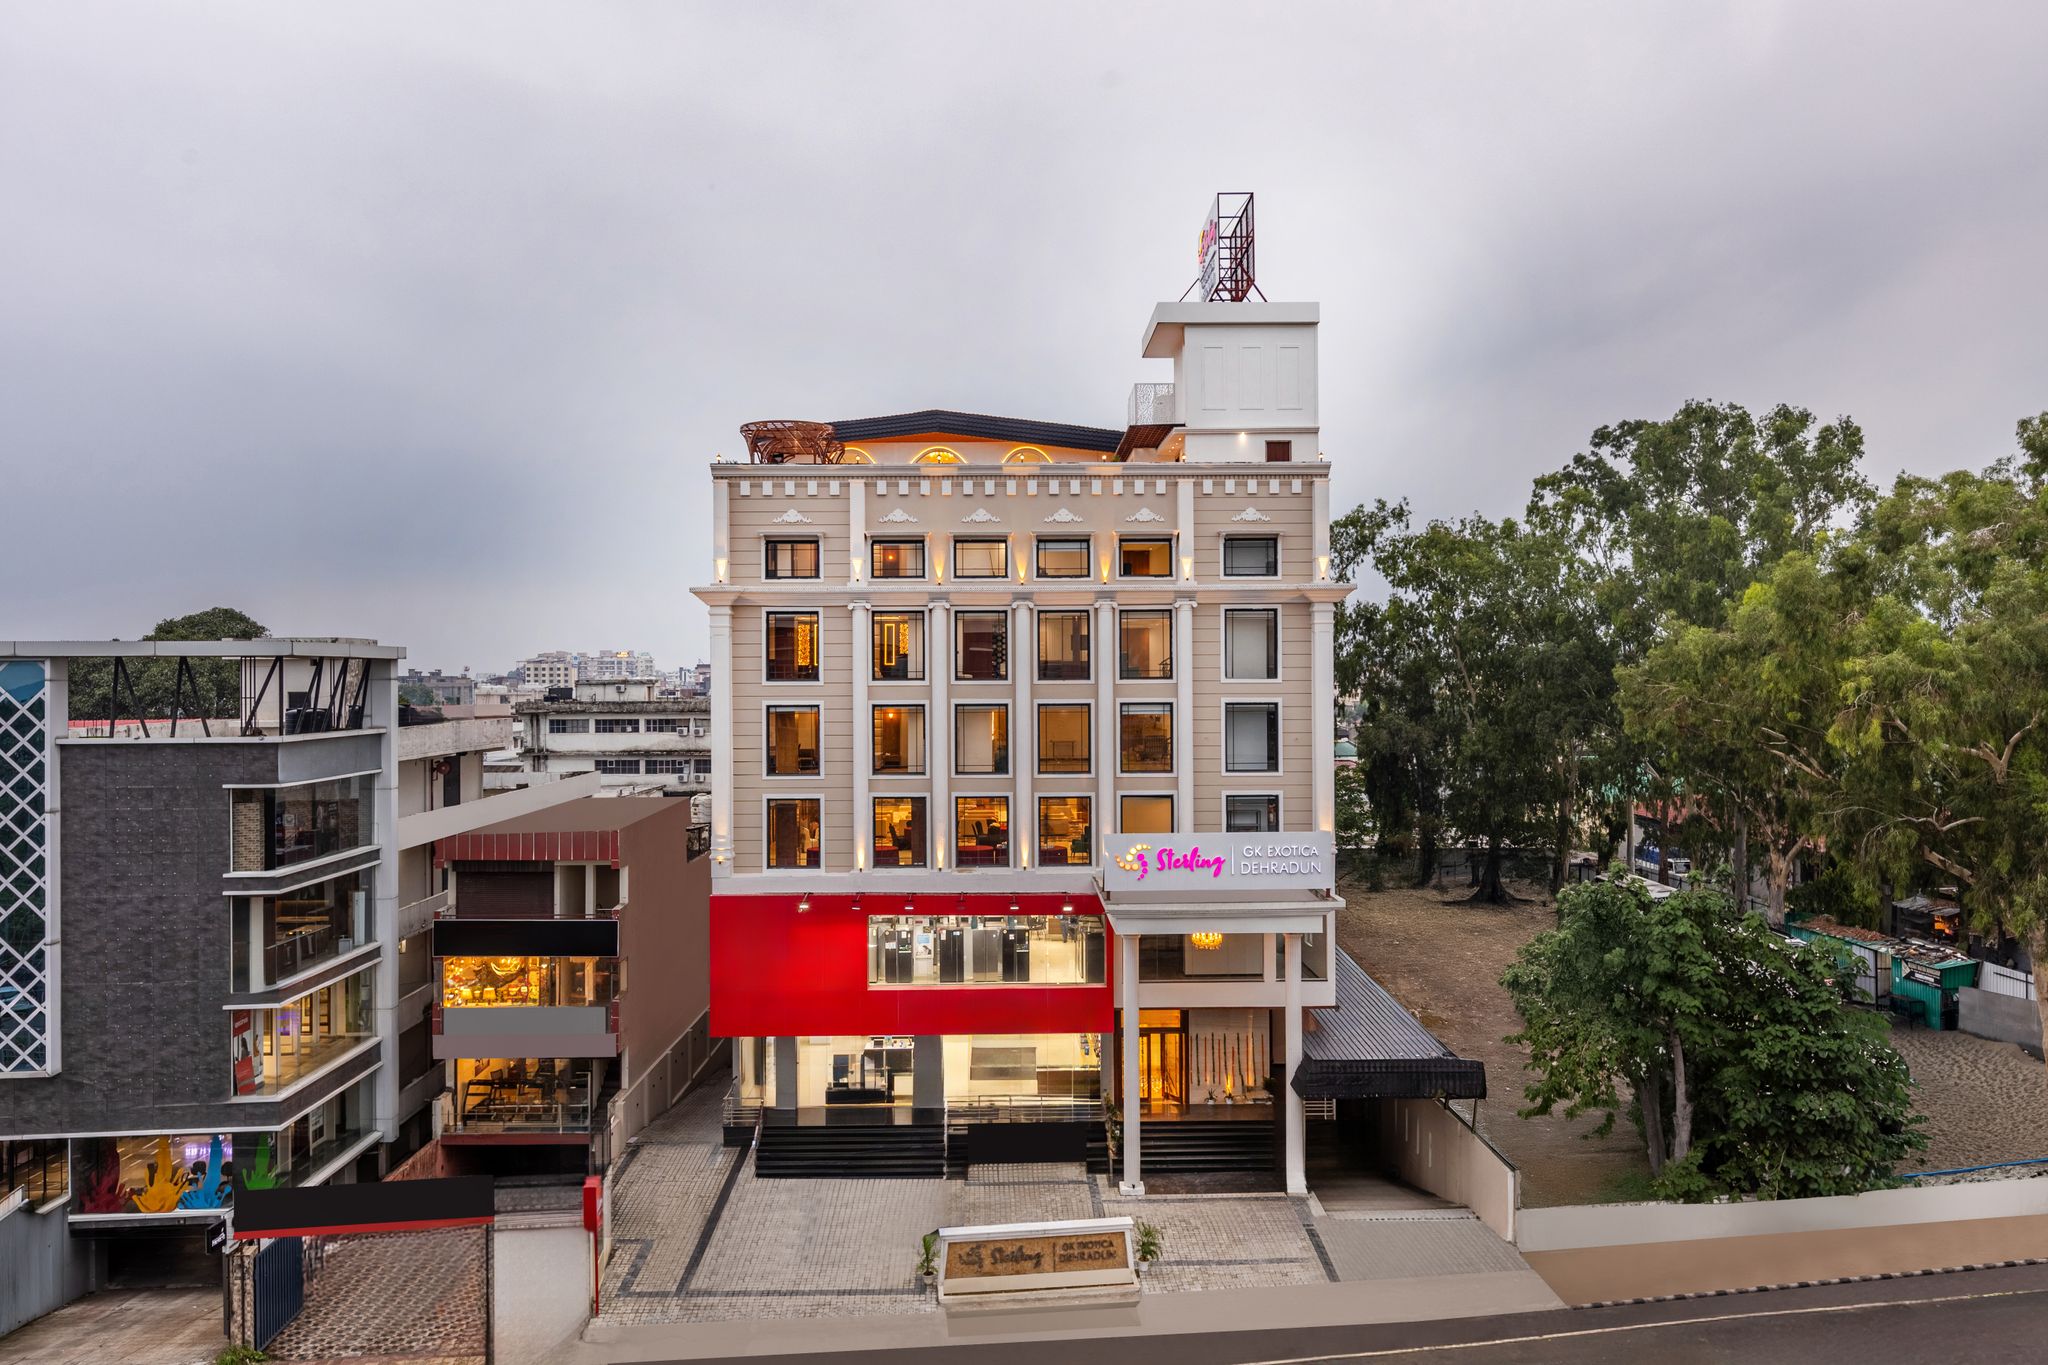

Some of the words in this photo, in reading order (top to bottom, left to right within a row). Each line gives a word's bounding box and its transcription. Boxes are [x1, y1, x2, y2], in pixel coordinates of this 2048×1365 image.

[1243, 846, 1262, 857] GK
[1267, 846, 1319, 857] EXOTICA
[1157, 846, 1226, 878] Sterling
[1241, 861, 1321, 875] DEHRADUN
